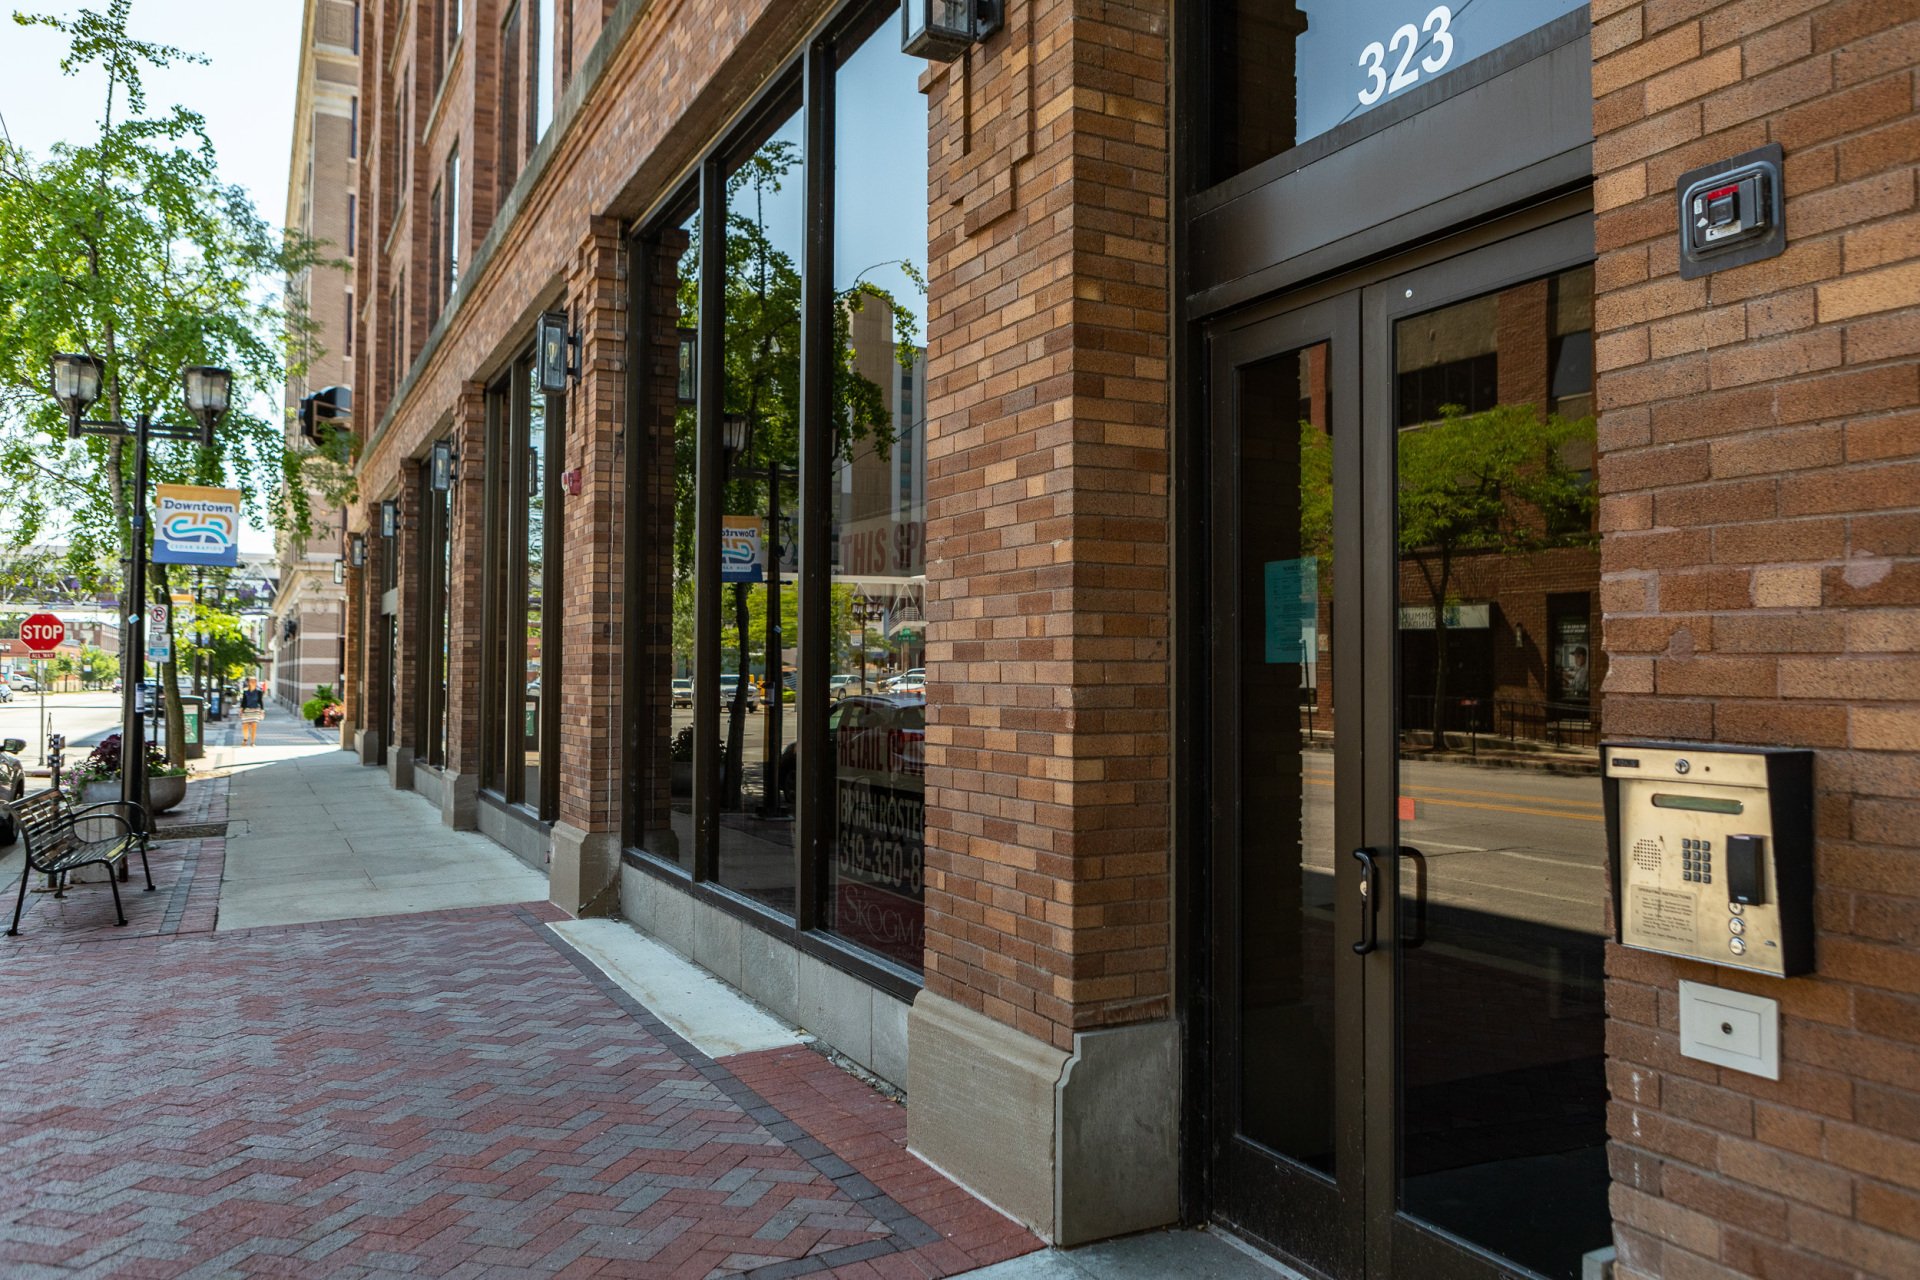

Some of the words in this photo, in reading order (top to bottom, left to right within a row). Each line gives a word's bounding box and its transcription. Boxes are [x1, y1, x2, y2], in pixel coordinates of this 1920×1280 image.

[1358, 5, 1454, 105] 323
[163, 499, 233, 513] Downtown
[841, 528, 886, 576] THIS
[22, 624, 63, 640] STOP
[840, 725, 883, 771] RETAIL
[840, 787, 877, 830] BRIAN
[840, 830, 922, 894] 319-350-8
